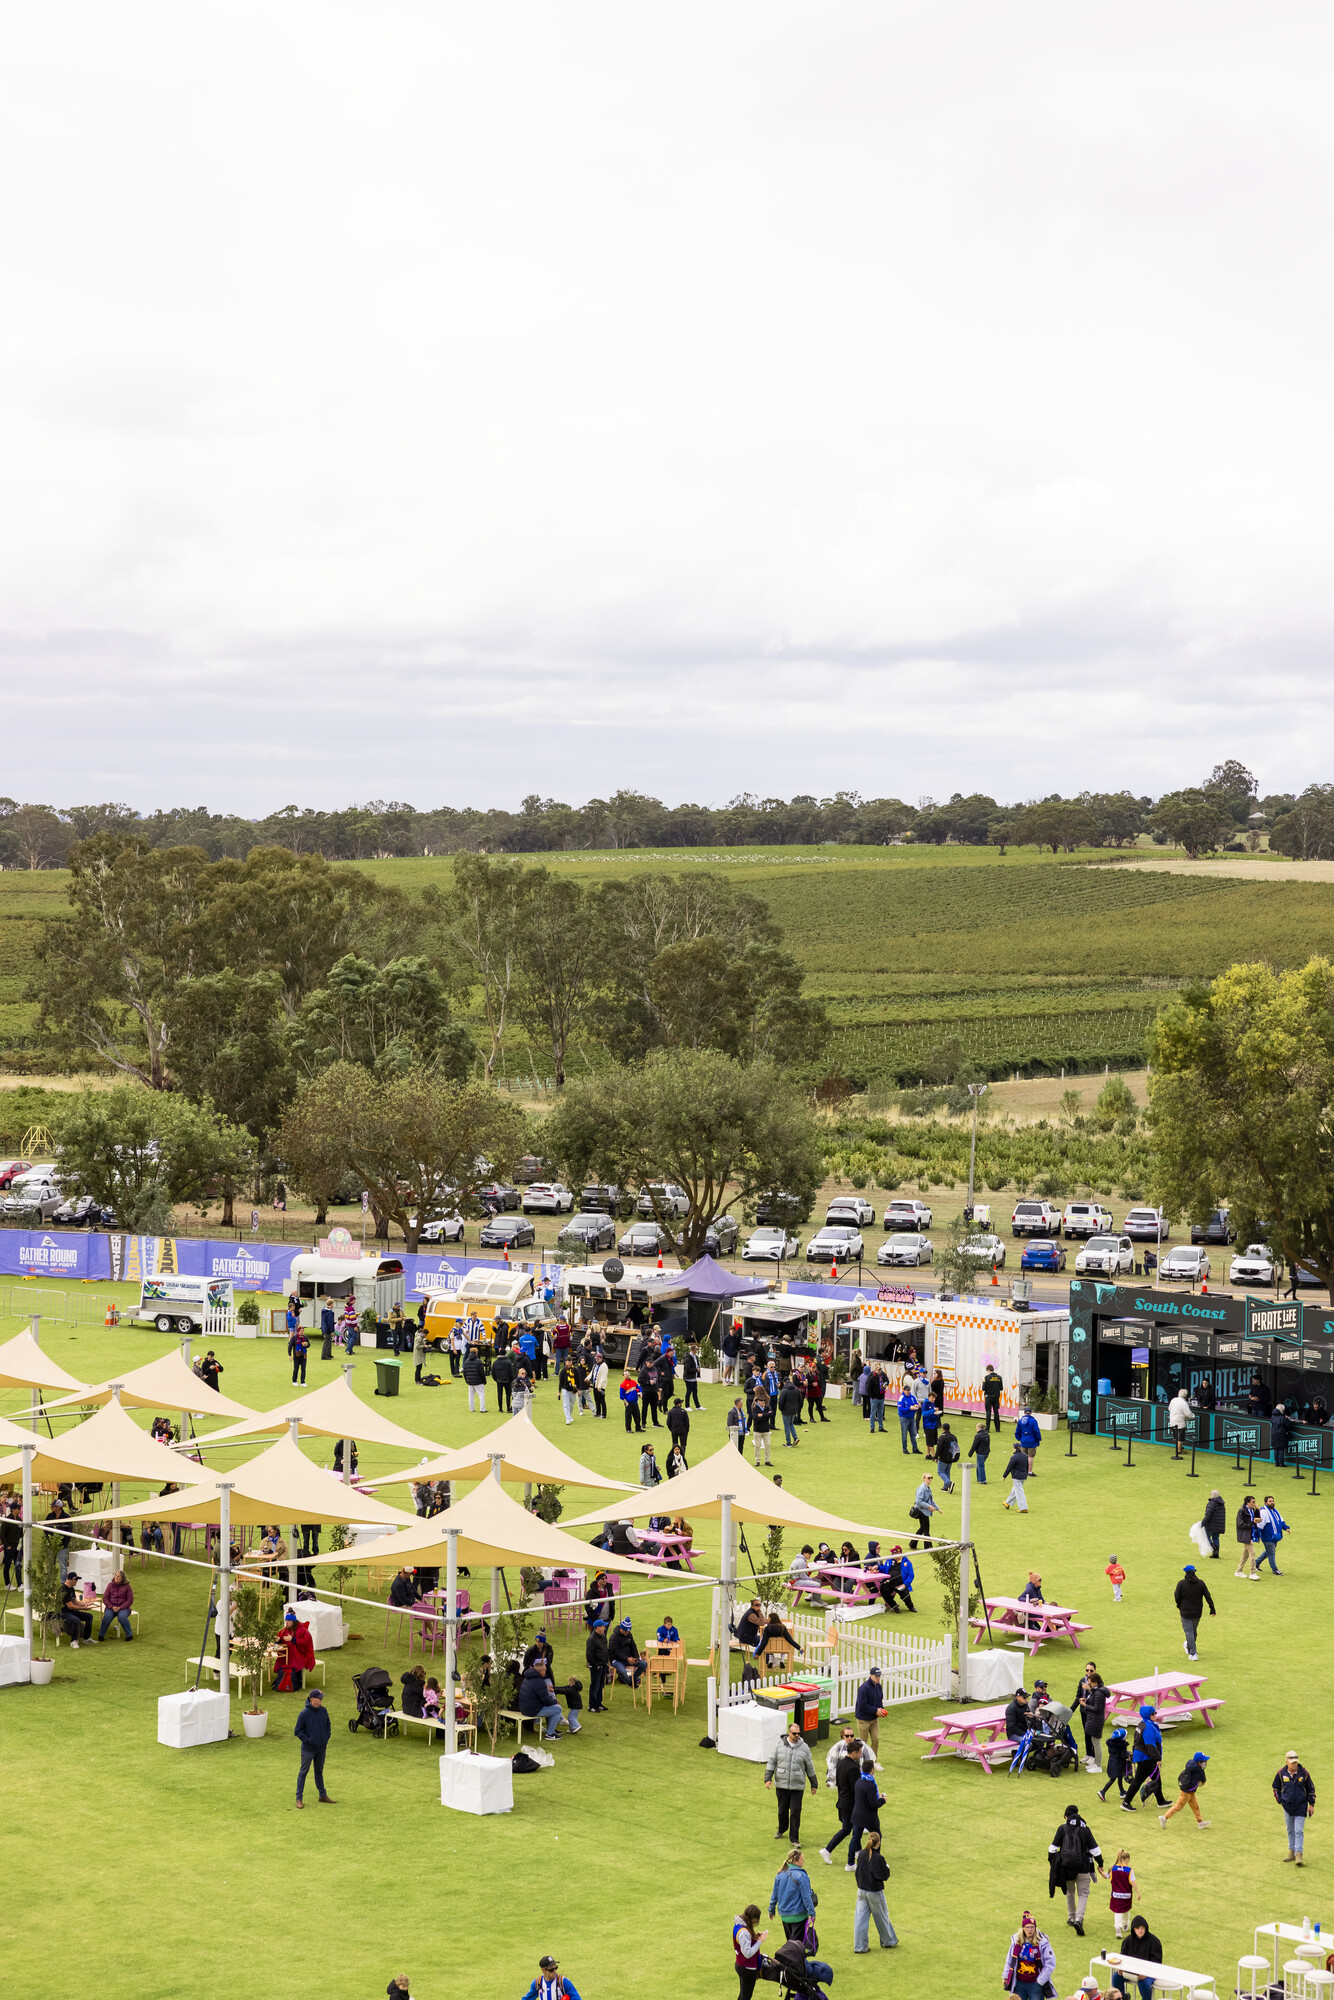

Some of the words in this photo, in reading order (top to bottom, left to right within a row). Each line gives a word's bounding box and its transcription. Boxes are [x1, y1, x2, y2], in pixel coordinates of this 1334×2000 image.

[19, 1247, 49, 1262] GATHER
[50, 1248, 78, 1263] ROUND
[110, 1235, 121, 1281] GATHER
[126, 1236, 141, 1282] ROUND
[145, 1236, 155, 1275] ATHER
[160, 1238, 174, 1273] OUND
[321, 1243, 332, 1252] ICE
[336, 1244, 359, 1254] CREAM
[212, 1258, 244, 1273] GATHER
[245, 1260, 270, 1275] ROUND
[415, 1271, 449, 1289] GATHER
[1134, 1298, 1180, 1315] South
[1181, 1303, 1227, 1320] Coast
